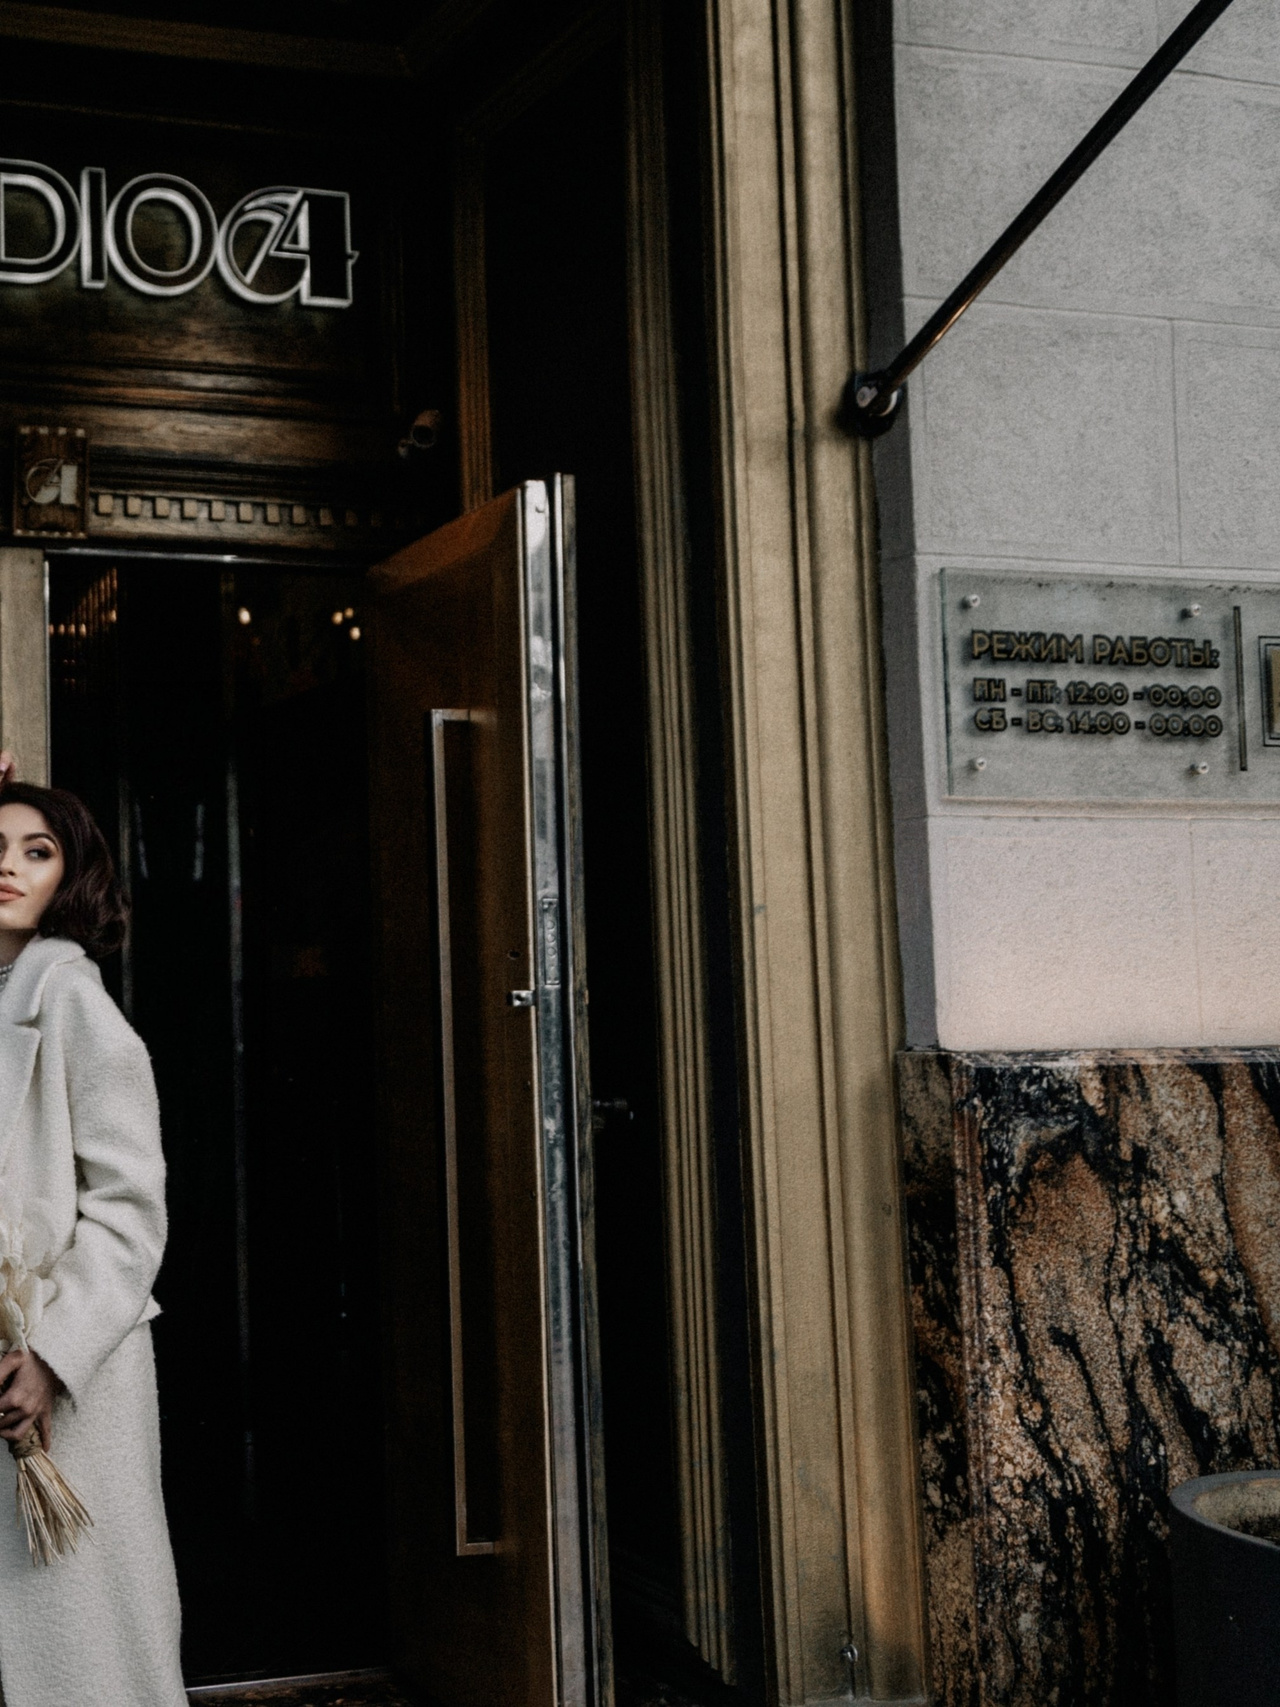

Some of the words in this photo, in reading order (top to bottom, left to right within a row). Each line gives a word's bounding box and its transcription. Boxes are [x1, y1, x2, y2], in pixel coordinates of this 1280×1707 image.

[972, 630, 1084, 663] РЕЖИМ
[1092, 634, 1220, 669] РАБОТЫ:
[973, 678, 1007, 702] ПН
[1026, 679, 1062, 704] ПТ:
[1065, 681, 1129, 706] 12:00
[1148, 684, 1222, 708] 00:00
[974, 707, 1007, 732] СБ
[1027, 709, 1064, 734] ВС:
[1067, 710, 1131, 735] 14:00
[1149, 713, 1223, 737] 00:00
